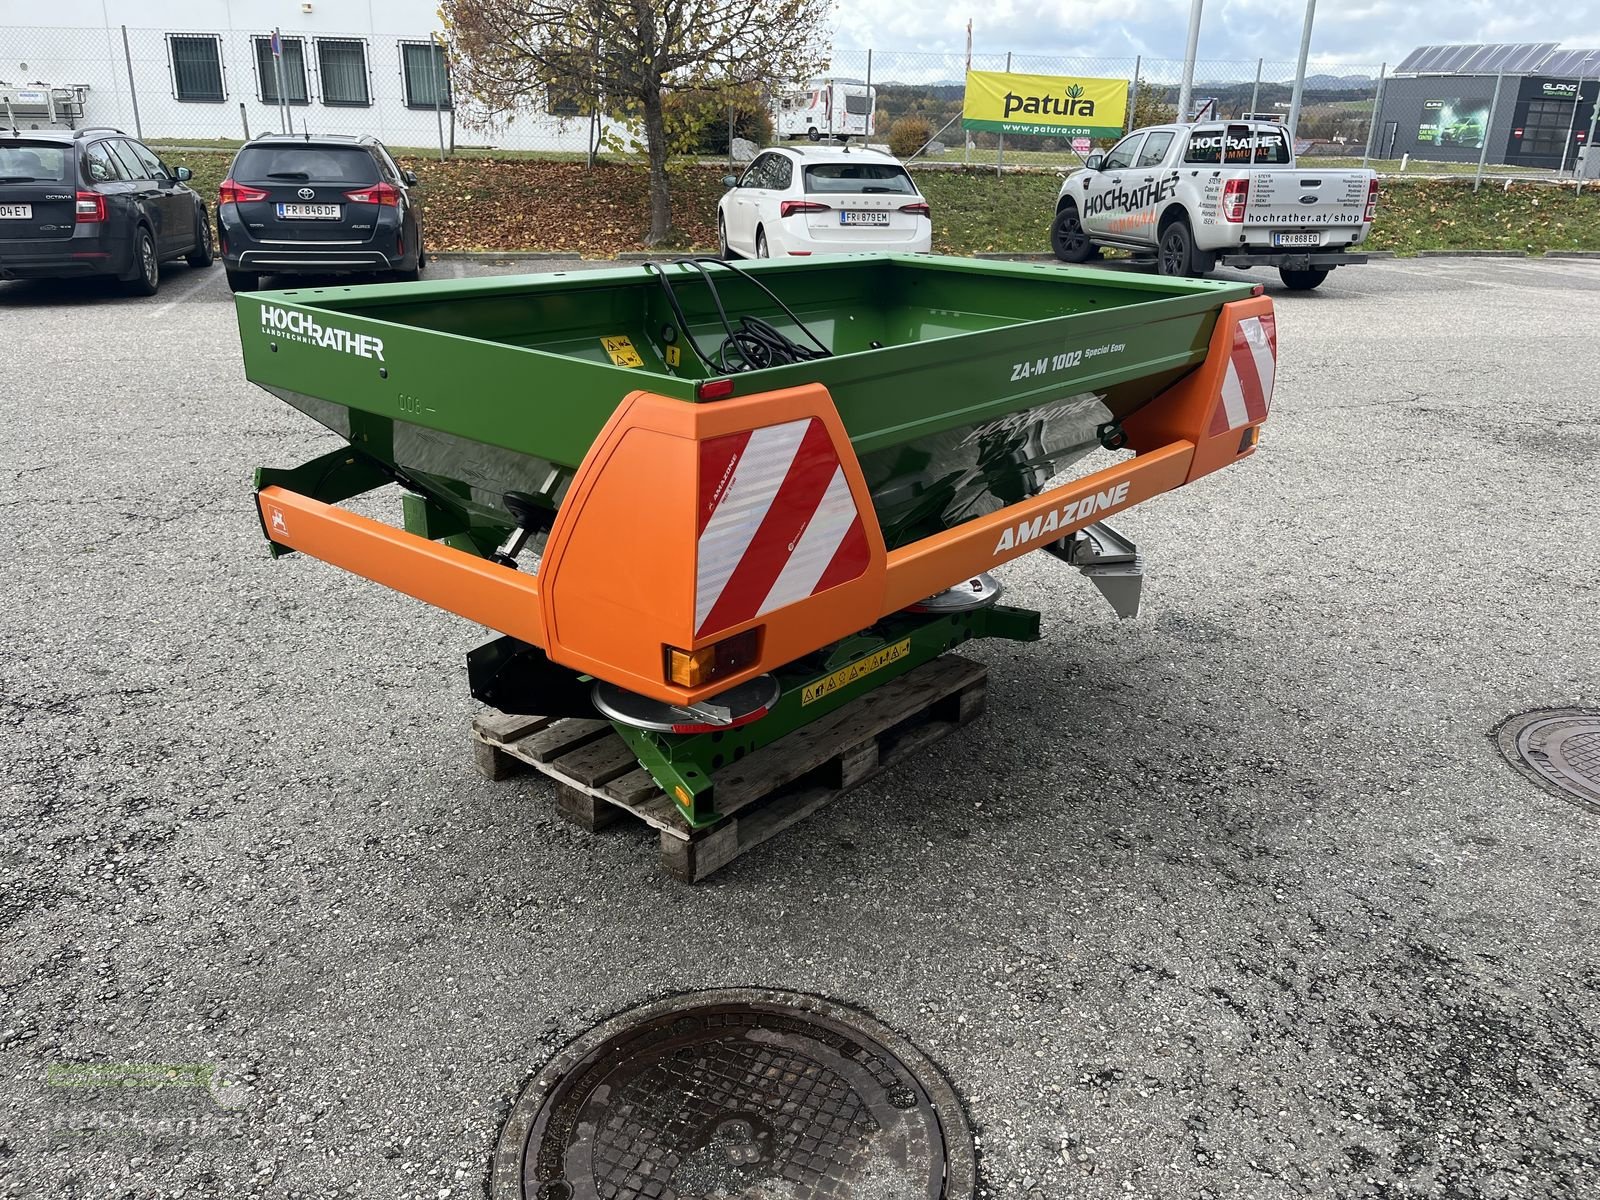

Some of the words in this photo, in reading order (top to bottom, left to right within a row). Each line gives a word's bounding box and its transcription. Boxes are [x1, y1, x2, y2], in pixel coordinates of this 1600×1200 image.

[1004, 91, 1095, 118] patura
[1003, 124, 1090, 135] www.patura.com
[1189, 135, 1282, 150] HOCHRATHER
[1083, 175, 1180, 219] HOCHRATHER
[1248, 213, 1360, 224] hochrather.at/shop
[260, 304, 385, 362] HOCHRATHER
[261, 326, 318, 346] LANDTECHNIK
[1010, 358, 1049, 382] ZA-M
[1051, 350, 1083, 372] 1002
[1084, 344, 1110, 359] Special
[1110, 343, 1126, 353] Easy
[713, 453, 738, 501] AMAZONE
[992, 481, 1131, 556] AMAZONE
